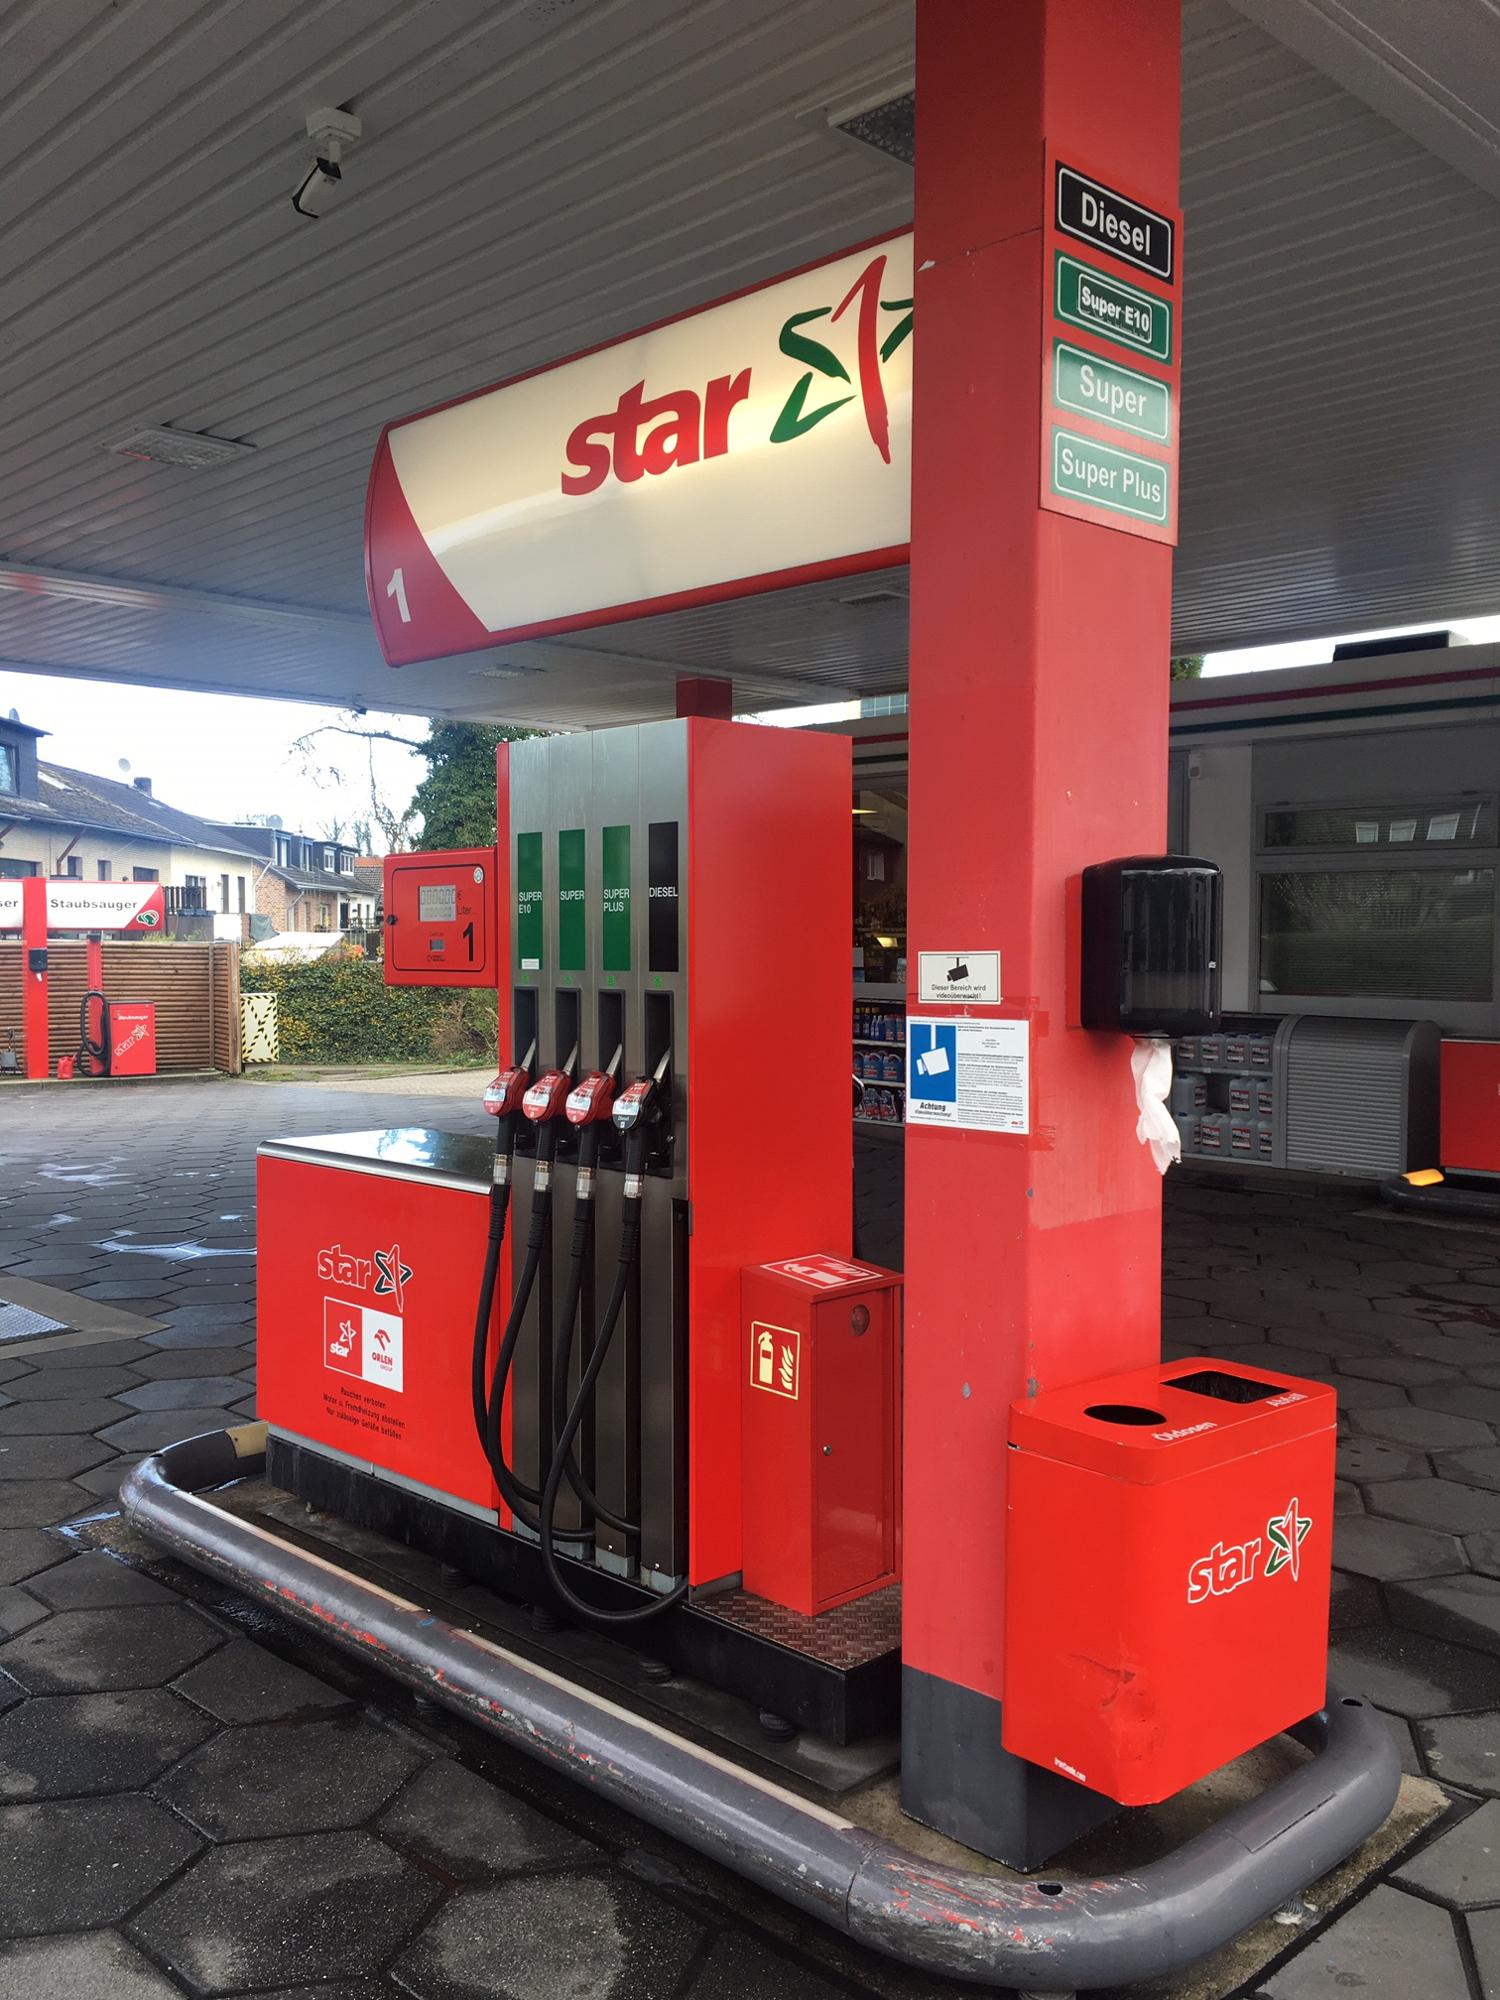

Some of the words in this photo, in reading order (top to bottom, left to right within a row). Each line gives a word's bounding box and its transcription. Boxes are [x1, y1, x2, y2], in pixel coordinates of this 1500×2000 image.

[1081, 191, 1151, 256] Diesel
[1081, 286, 1121, 319] Super
[1124, 305, 1150, 332] E10
[1079, 364, 1147, 417] Super
[560, 366, 753, 496] star
[1061, 447, 1118, 489] Super
[1123, 467, 1161, 503] Plus
[386, 567, 412, 623] 1
[518, 890, 543, 902] SUPER
[559, 889, 585, 901] SUPER
[602, 888, 630, 900] SUPER
[648, 886, 679, 899] DIESEL
[50, 898, 138, 911] Staubsauger
[518, 903, 532, 915] E10
[602, 901, 625, 913] PLUS
[462, 921, 474, 961] 1
[931, 983, 950, 991] Dieser
[950, 983, 972, 991] Bereich
[936, 992, 982, 1000] videoüberwacht!
[919, 1101, 947, 1112] Achtung
[317, 1243, 372, 1290] star
[329, 1341, 350, 1358] star
[371, 1351, 393, 1366] ORLEN
[363, 1395, 386, 1409] verboten
[1151, 1421, 1218, 1441] Öldosen
[1187, 1537, 1262, 1604] star
